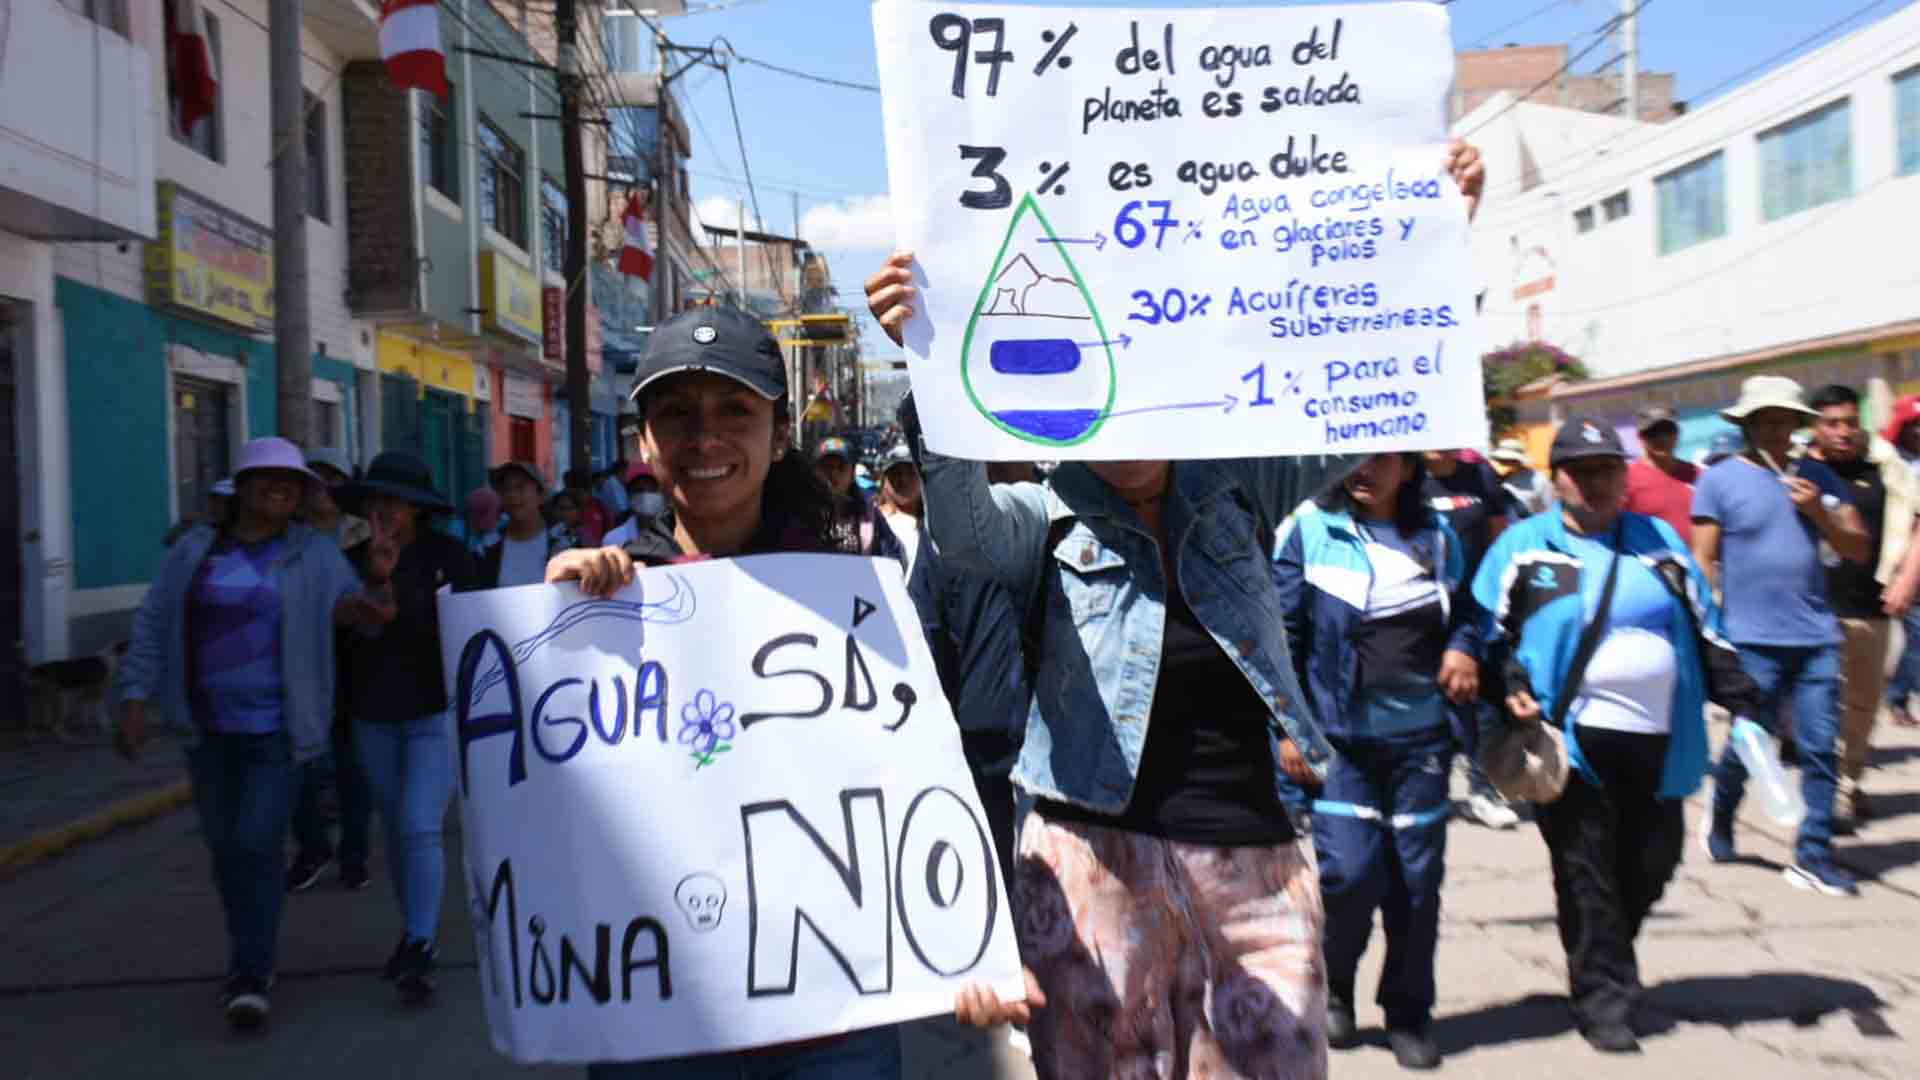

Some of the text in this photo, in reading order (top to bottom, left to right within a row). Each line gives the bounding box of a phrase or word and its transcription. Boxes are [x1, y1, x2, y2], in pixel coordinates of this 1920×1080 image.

[929, 12, 1343, 100] 97 % del agua del
[1083, 72, 1361, 135] planeta es salada
[957, 133, 1349, 211] 3 % es agua dulce
[1222, 192, 1291, 224] Agua
[1220, 216, 1416, 252] en glaciares y
[1311, 239, 1378, 267] polos
[1227, 278, 1379, 316] Acuíferas
[1324, 356, 1400, 392] para
[1414, 340, 1445, 375] el
[1304, 391, 1417, 419] consumo
[1325, 411, 1428, 444] humano
[456, 629, 670, 797] AGUA
[740, 786, 998, 999] NO
